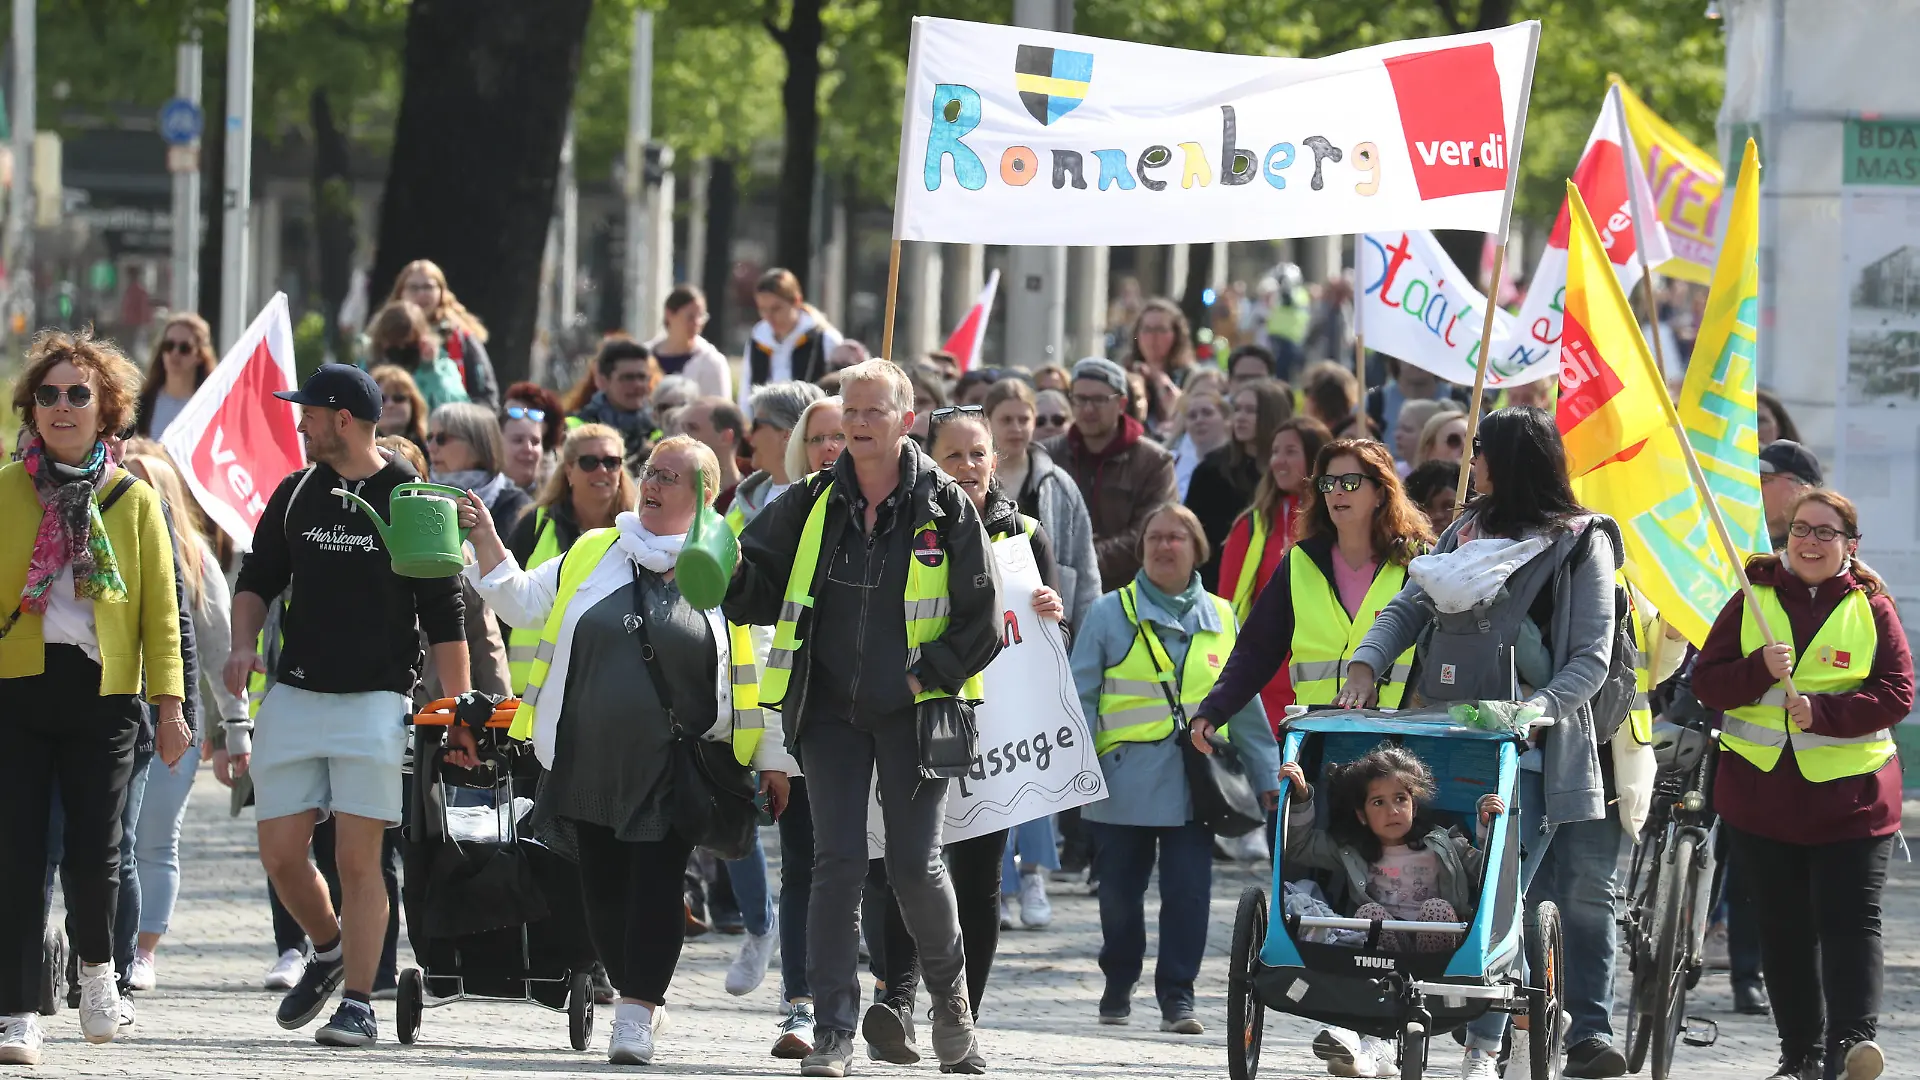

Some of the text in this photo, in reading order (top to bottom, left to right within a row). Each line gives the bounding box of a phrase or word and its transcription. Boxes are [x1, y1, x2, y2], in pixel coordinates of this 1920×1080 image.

[924, 84, 1381, 197] Ronnenberg
[1414, 132, 1504, 170] ver.di
[319, 543, 353, 552] HANNOVER
[1353, 955, 1396, 970] THULE
